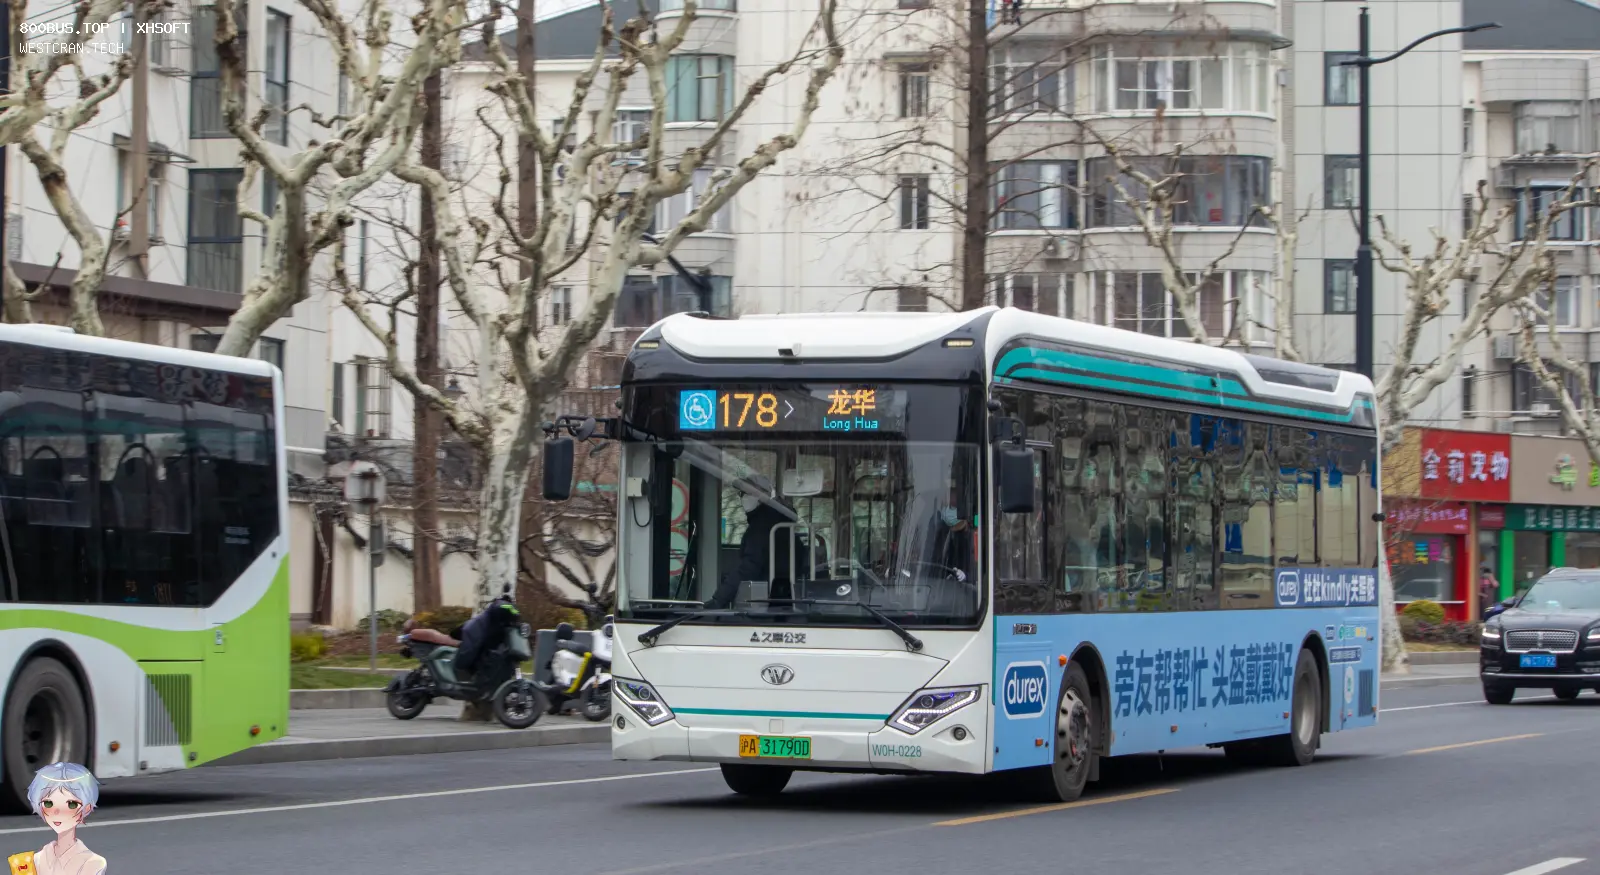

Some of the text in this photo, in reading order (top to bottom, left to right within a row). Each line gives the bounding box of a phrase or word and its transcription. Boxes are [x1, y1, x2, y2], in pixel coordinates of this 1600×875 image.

[719, 393, 778, 428] 178
[828, 388, 876, 416] 龙华
[823, 417, 879, 431] Long Hua
[1007, 670, 1045, 704] durex
[1115, 641, 1294, 719] 旁友帮帮忙 头盔戴戴好
